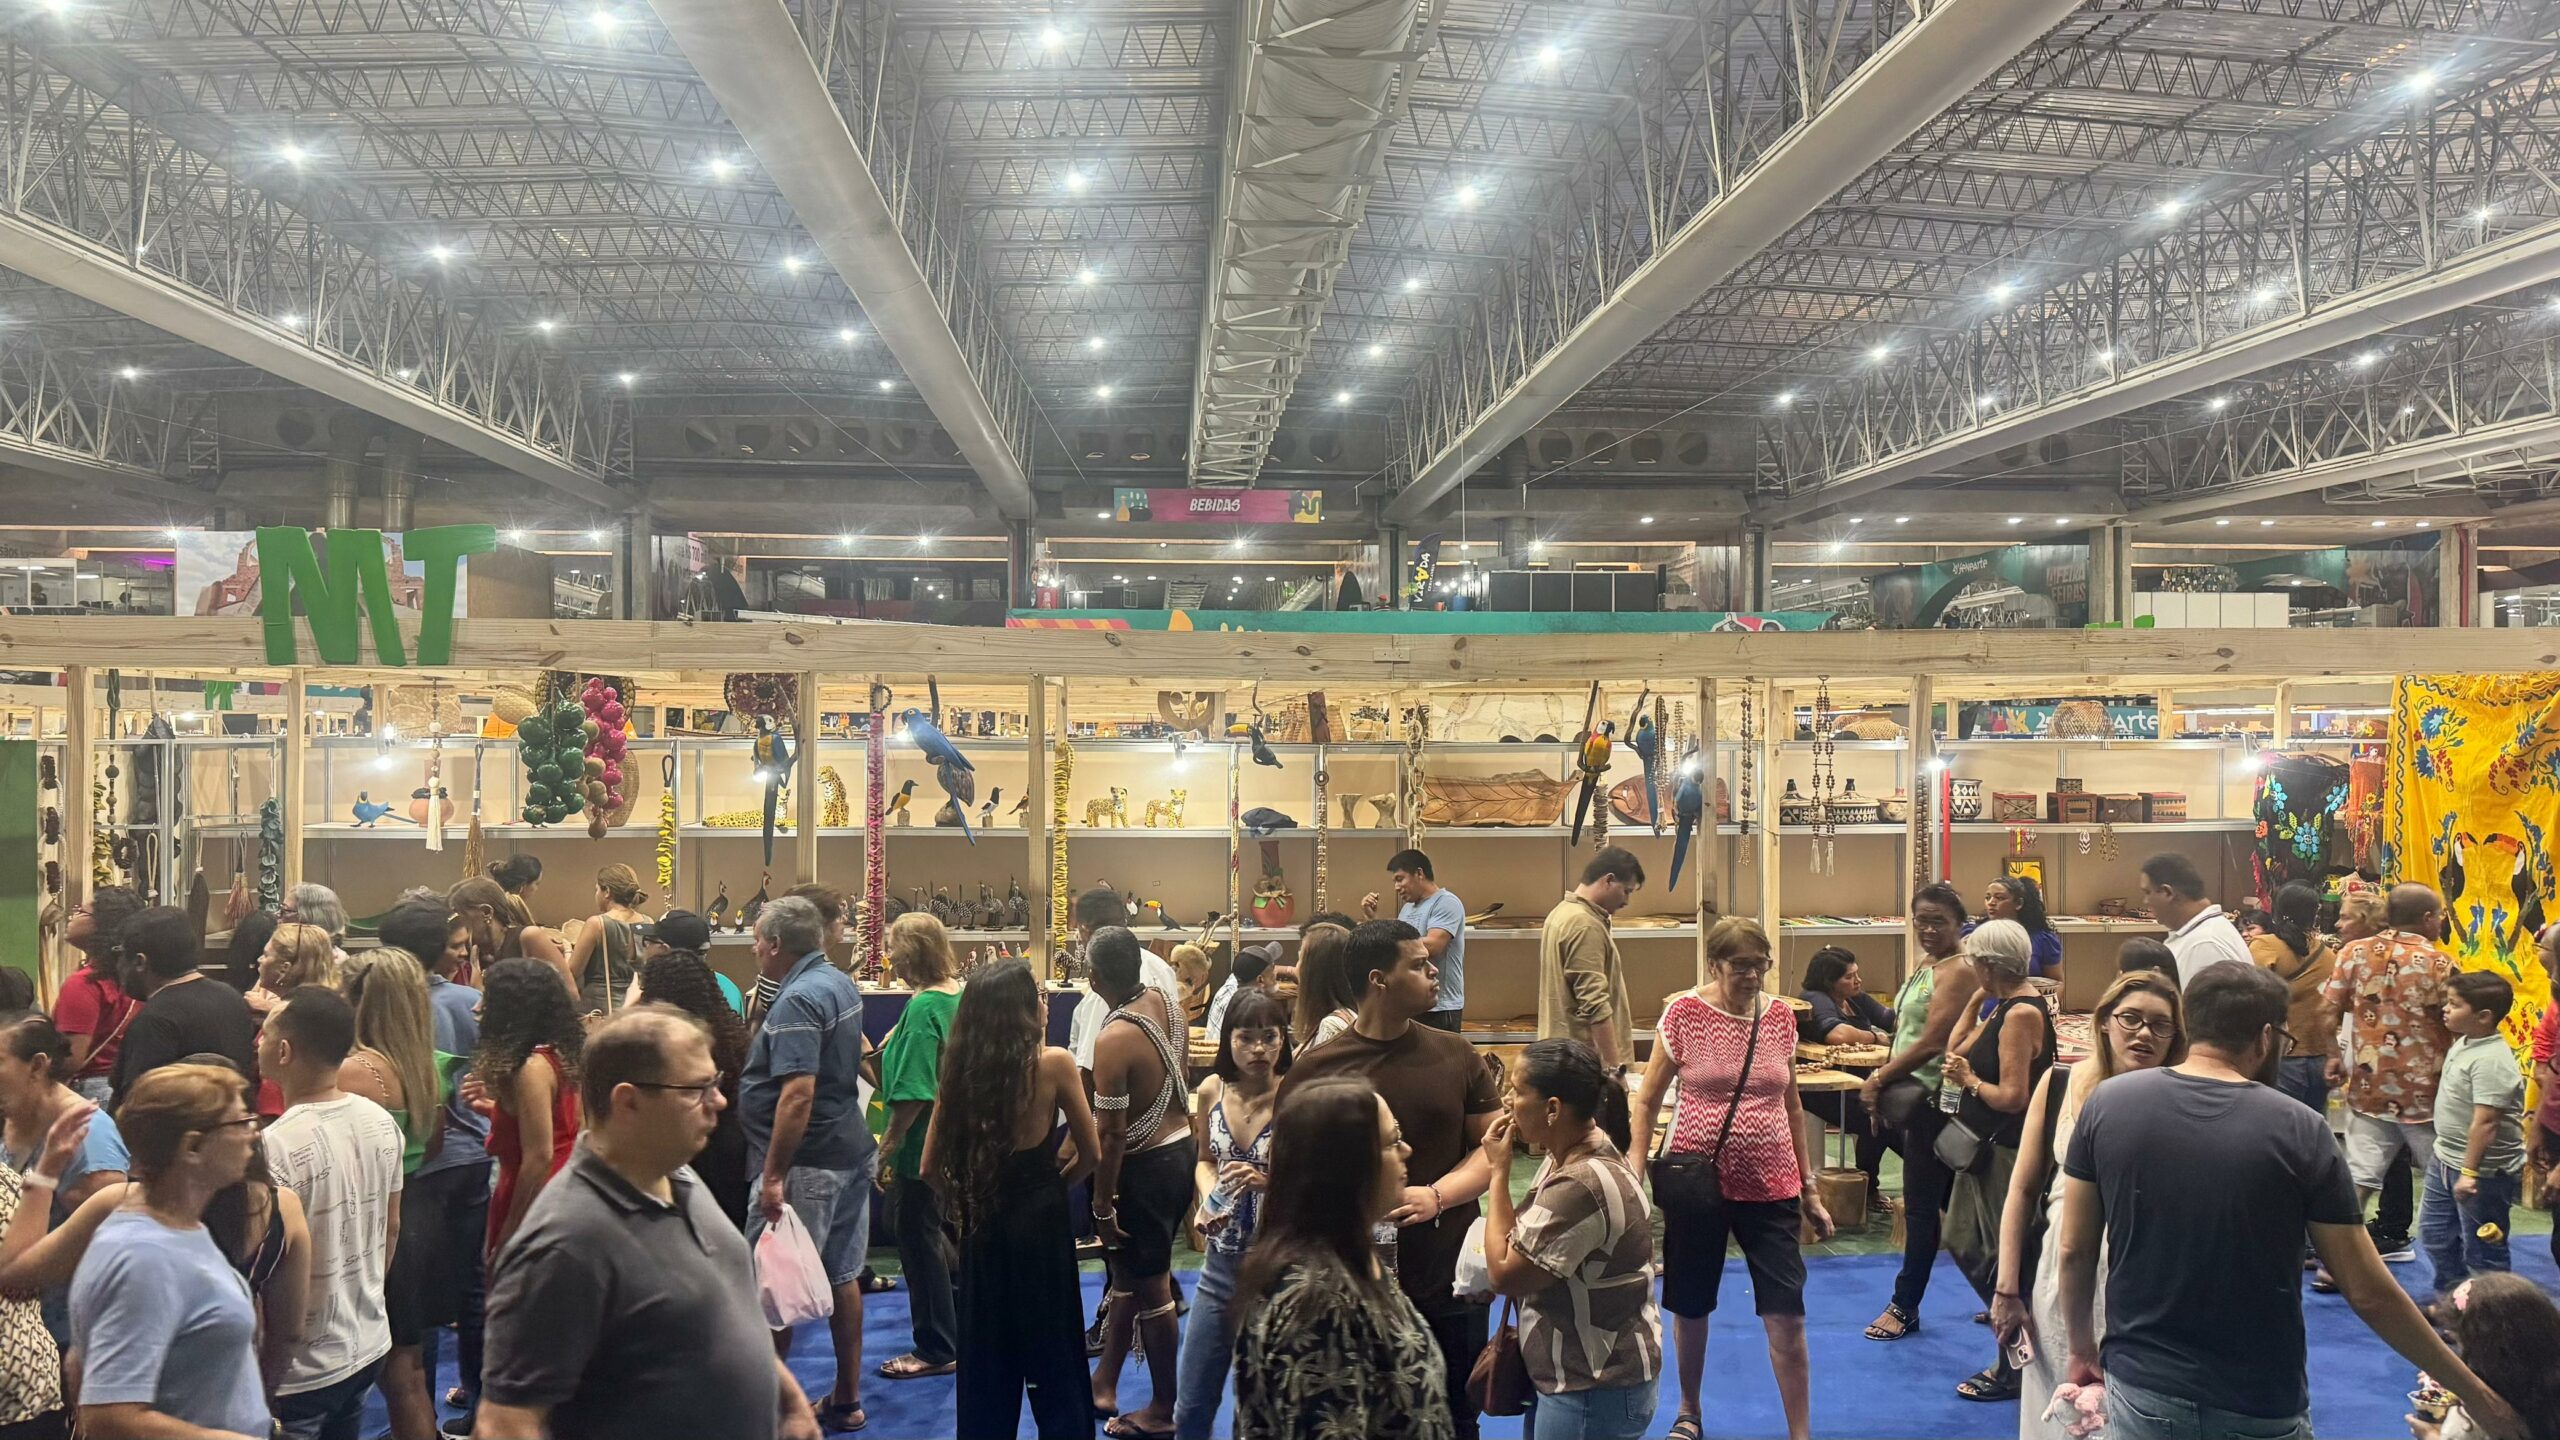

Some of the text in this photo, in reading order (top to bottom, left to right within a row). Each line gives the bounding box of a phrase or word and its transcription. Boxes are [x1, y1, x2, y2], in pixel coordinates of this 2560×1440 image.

[1189, 497, 1241, 513] BEBIDAS
[256, 524, 497, 666] MT
[1413, 552, 1431, 602] VIRADA
